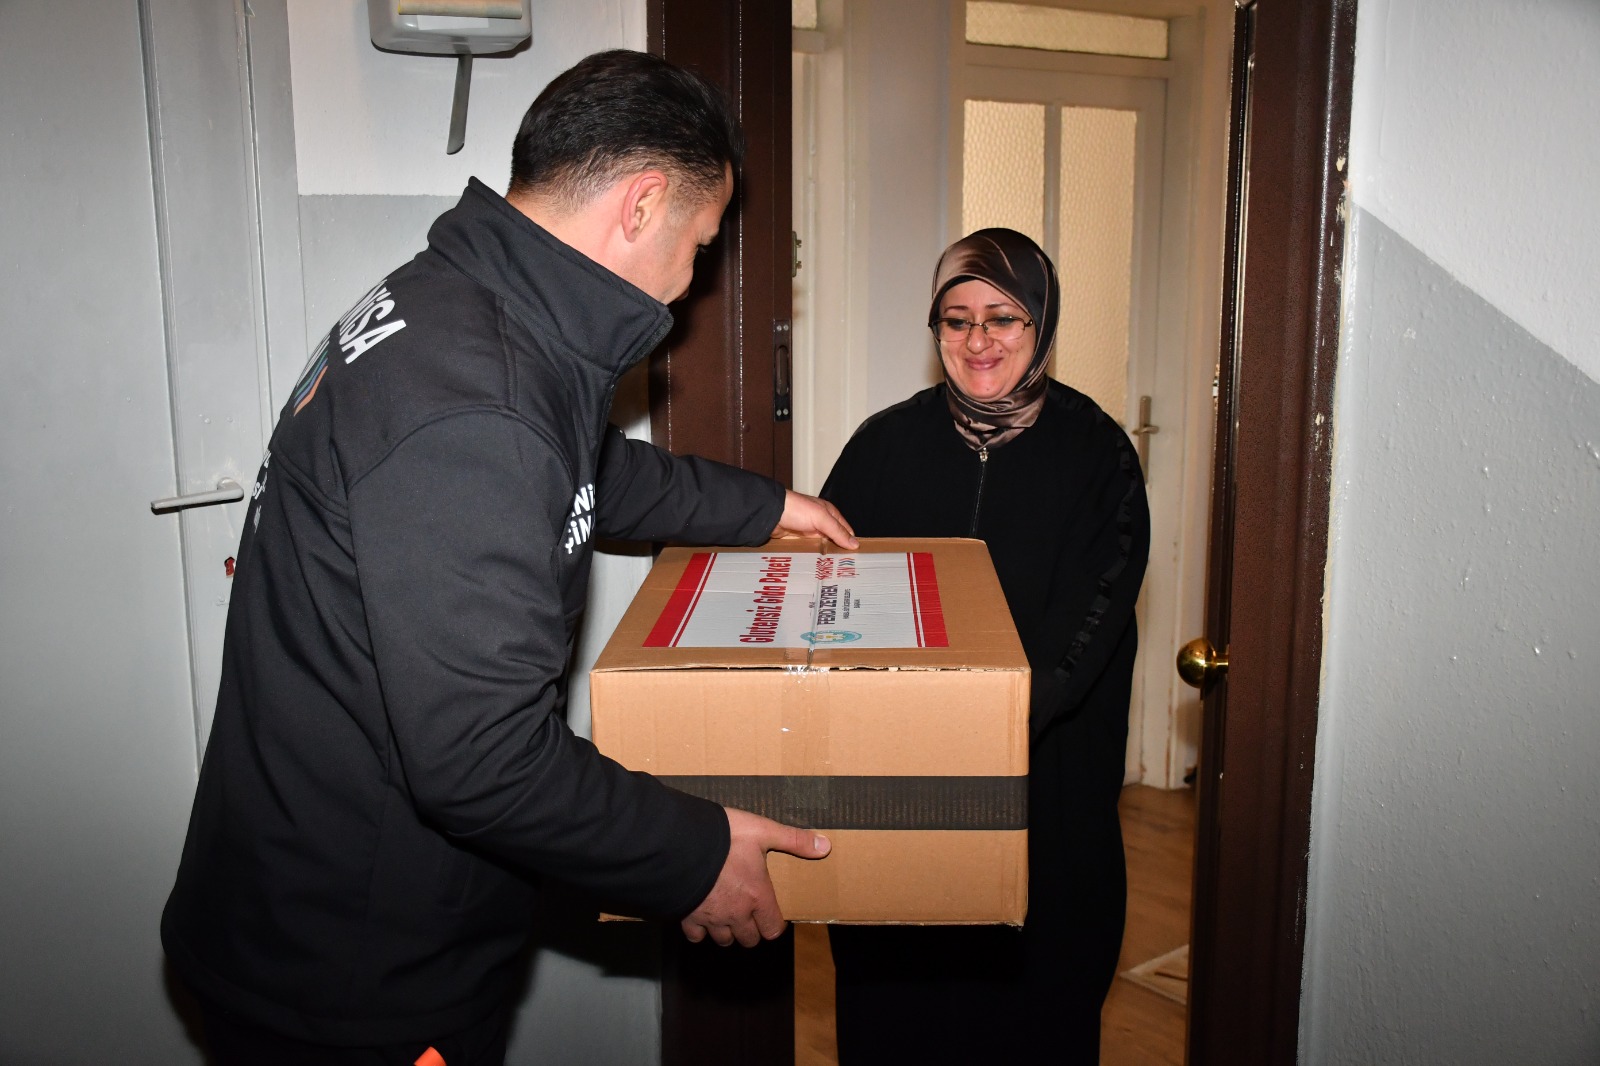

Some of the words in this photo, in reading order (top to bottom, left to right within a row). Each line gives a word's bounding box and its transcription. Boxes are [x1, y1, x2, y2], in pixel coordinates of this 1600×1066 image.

[339, 279, 407, 364] NİSA
[758, 556, 792, 584] Paketi
[753, 586, 787, 604] Gıda
[819, 585, 839, 608] ZEYREK
[739, 606, 783, 643] Glutensiz
